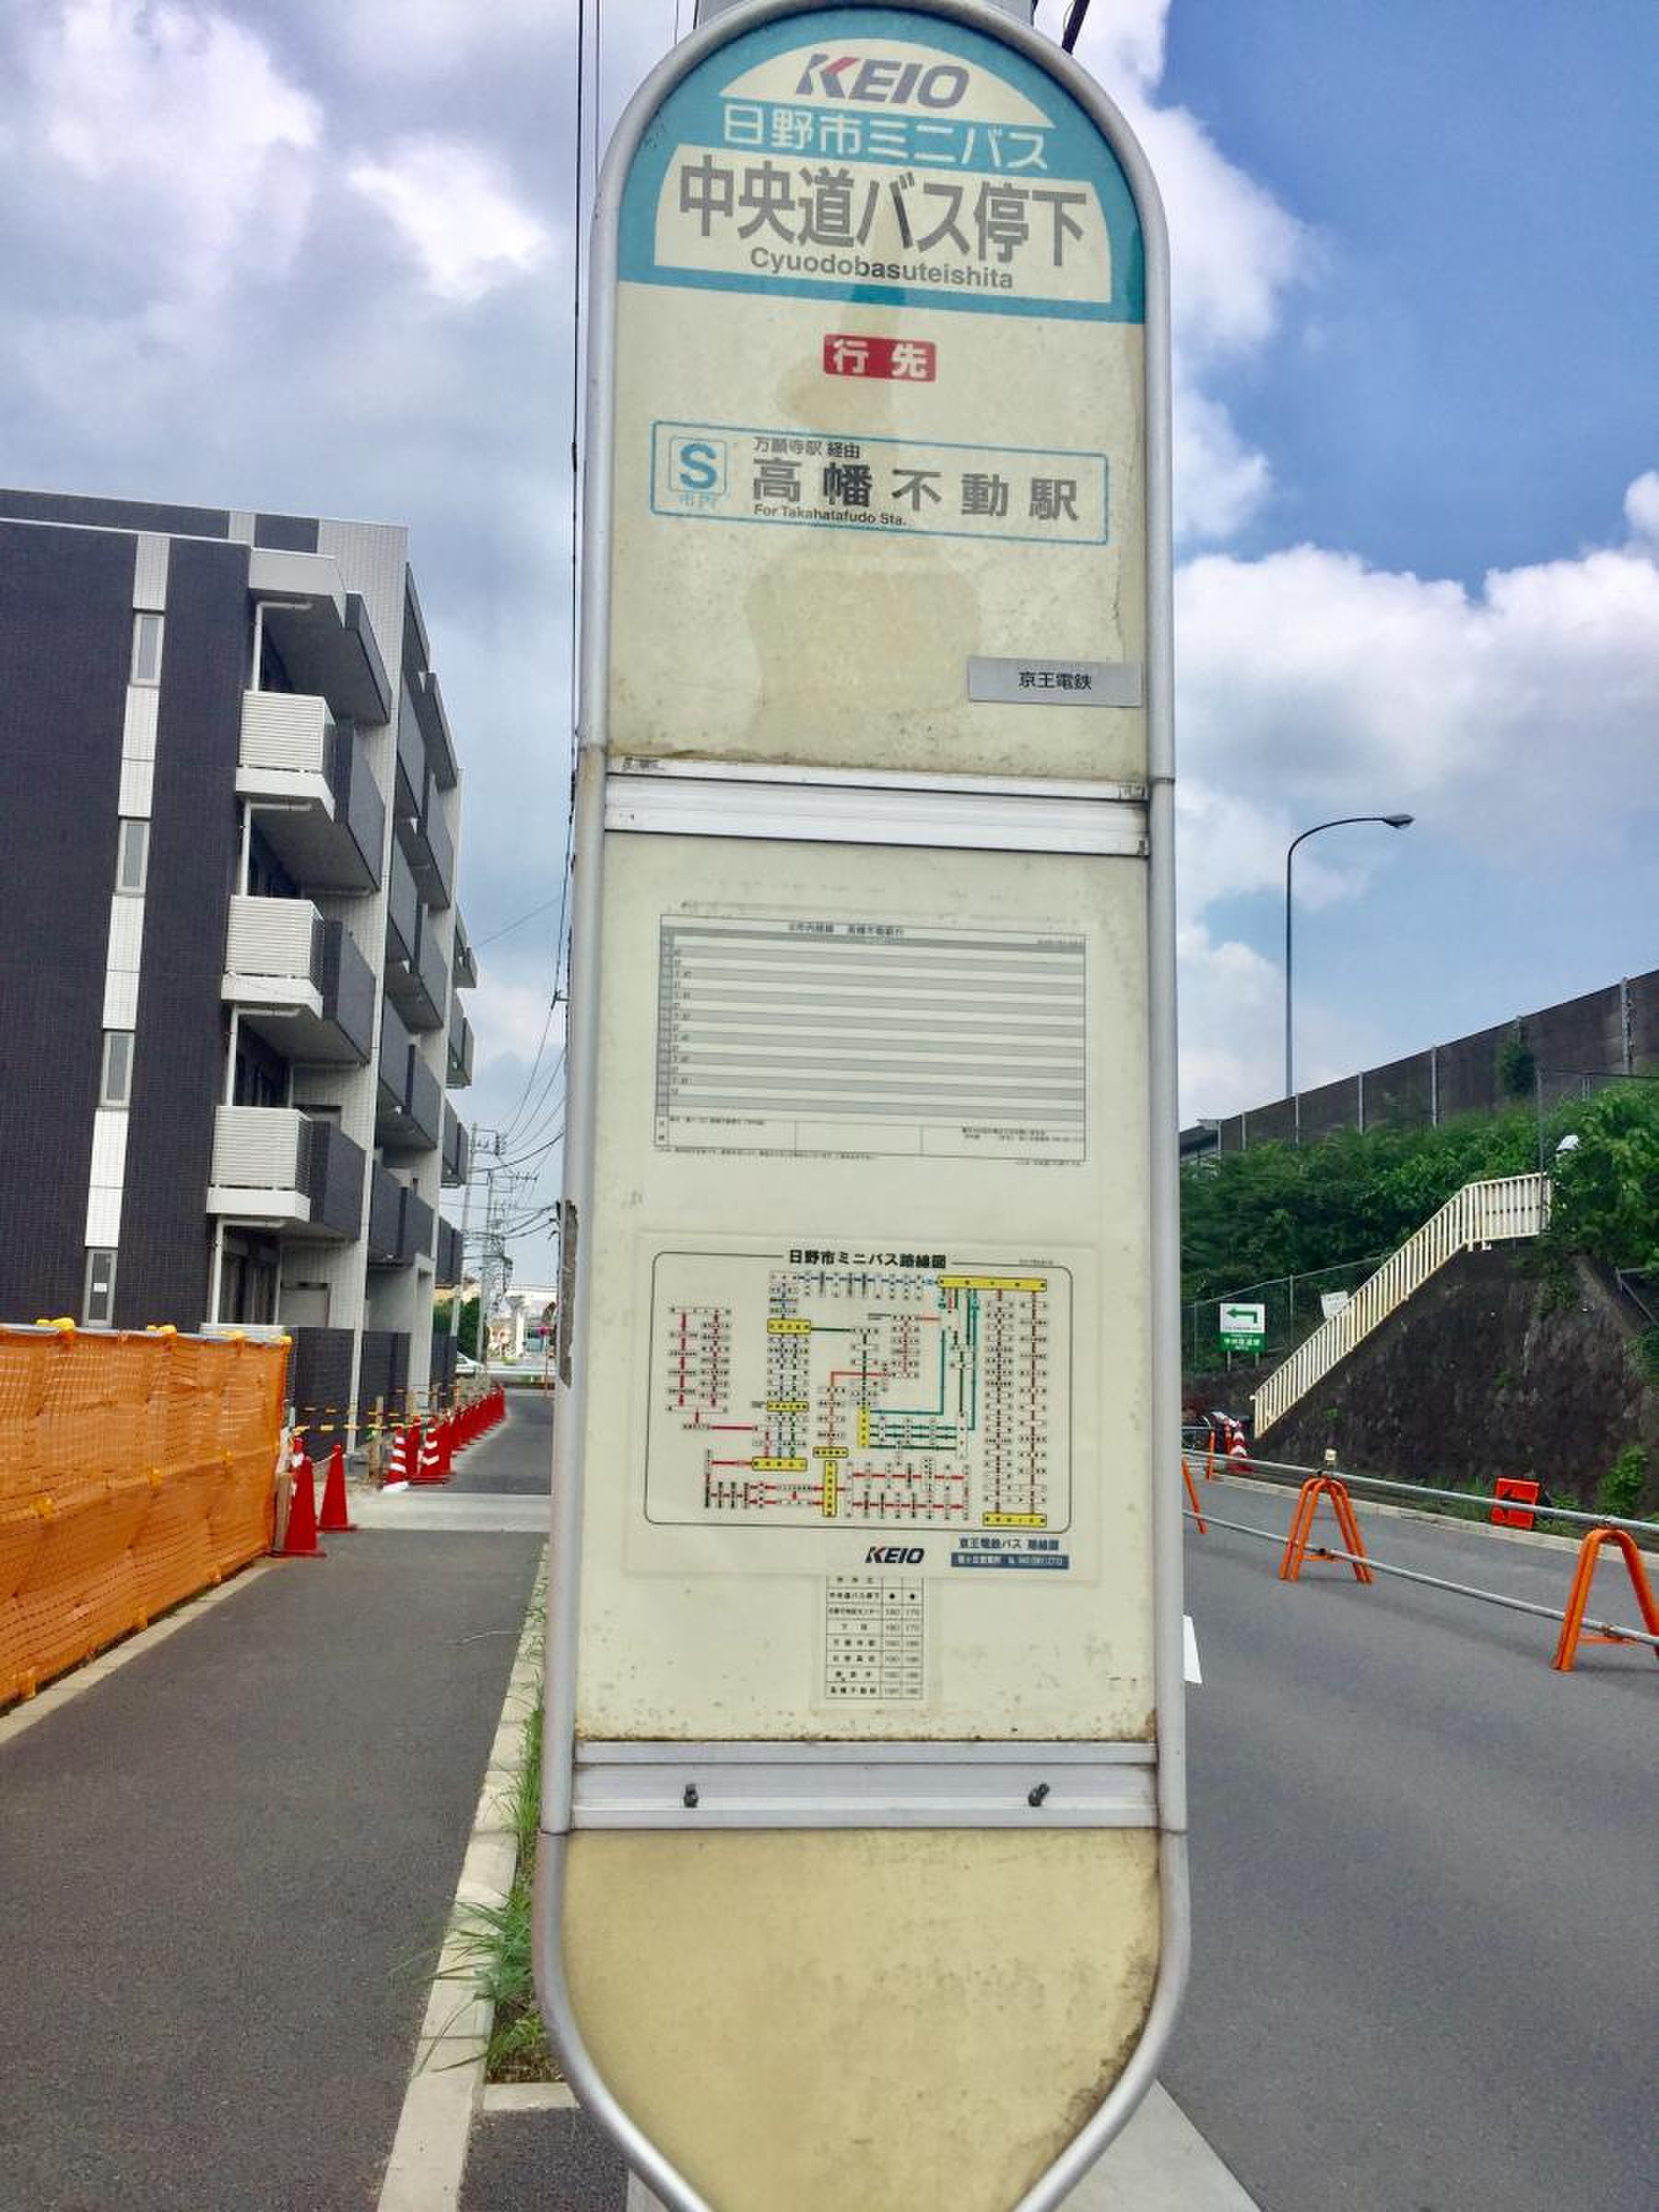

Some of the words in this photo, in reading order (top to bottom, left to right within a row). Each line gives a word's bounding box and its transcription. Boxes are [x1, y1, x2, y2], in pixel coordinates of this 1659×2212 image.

[796, 53, 969, 109] KEIO
[723, 103, 1047, 171] 日野市ミニバス
[679, 154, 1087, 266] 中央道バス停下
[749, 246, 1014, 290] Cyuodobasuteishita
[835, 338, 929, 377] 行先
[679, 442, 717, 489] S
[827, 441, 861, 459] 経由
[752, 458, 1079, 522] 高幡不動駅
[753, 503, 780, 517] For
[782, 504, 877, 525] Takahatafudo
[880, 512, 907, 526] Sta.
[1018, 670, 1092, 689] 京王電鉄
[790, 1249, 947, 1269] 日野市ミニバス路線図
[865, 1547, 925, 1564] KEIO
